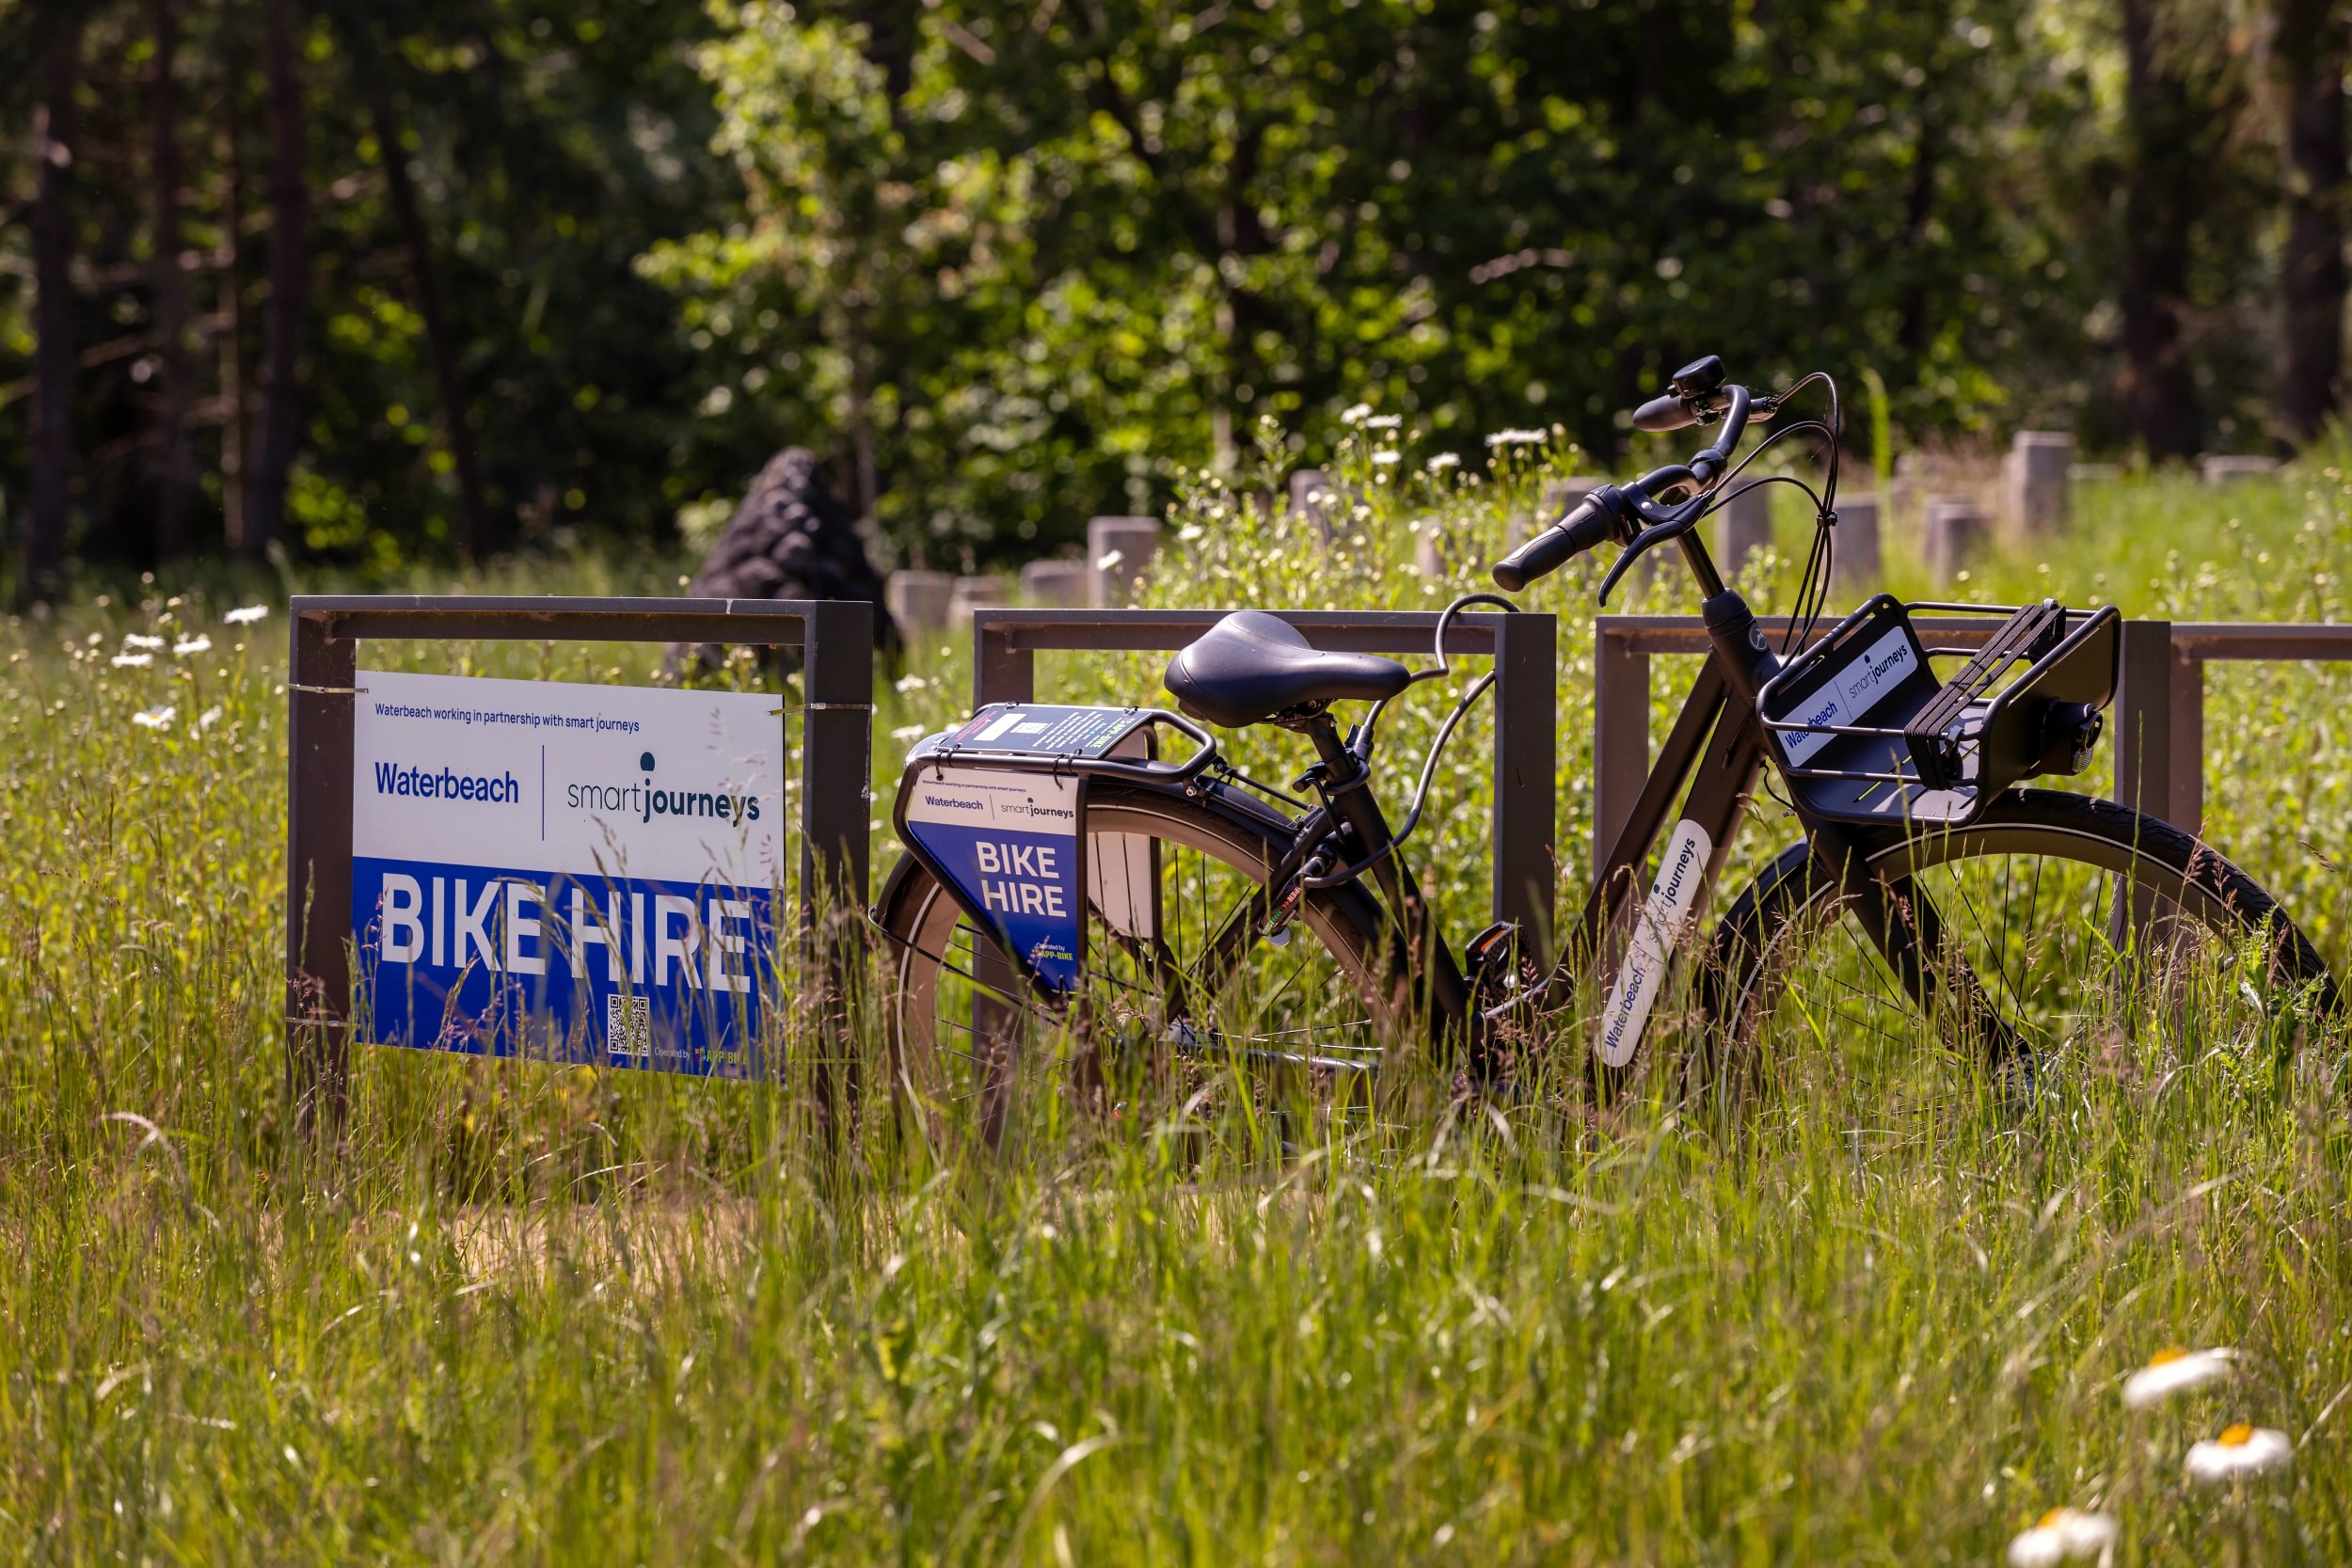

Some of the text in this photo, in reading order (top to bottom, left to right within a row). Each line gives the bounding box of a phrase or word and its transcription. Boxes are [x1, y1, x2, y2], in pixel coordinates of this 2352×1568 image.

[375, 704, 640, 735] Waterbeach working in partnership with smart journeys
[1785, 701, 1838, 749] Watebeach
[375, 762, 519, 803] Waterbeach
[925, 796, 983, 811] Waterbeach
[976, 841, 1059, 879] BIKE
[981, 879, 1067, 917] HIRE
[381, 872, 752, 993] BIKE HIRE
[1041, 950, 1073, 960] APP-BIKE
[1605, 963, 1646, 1049] Waterbeach
[683, 1049, 691, 1061] by
